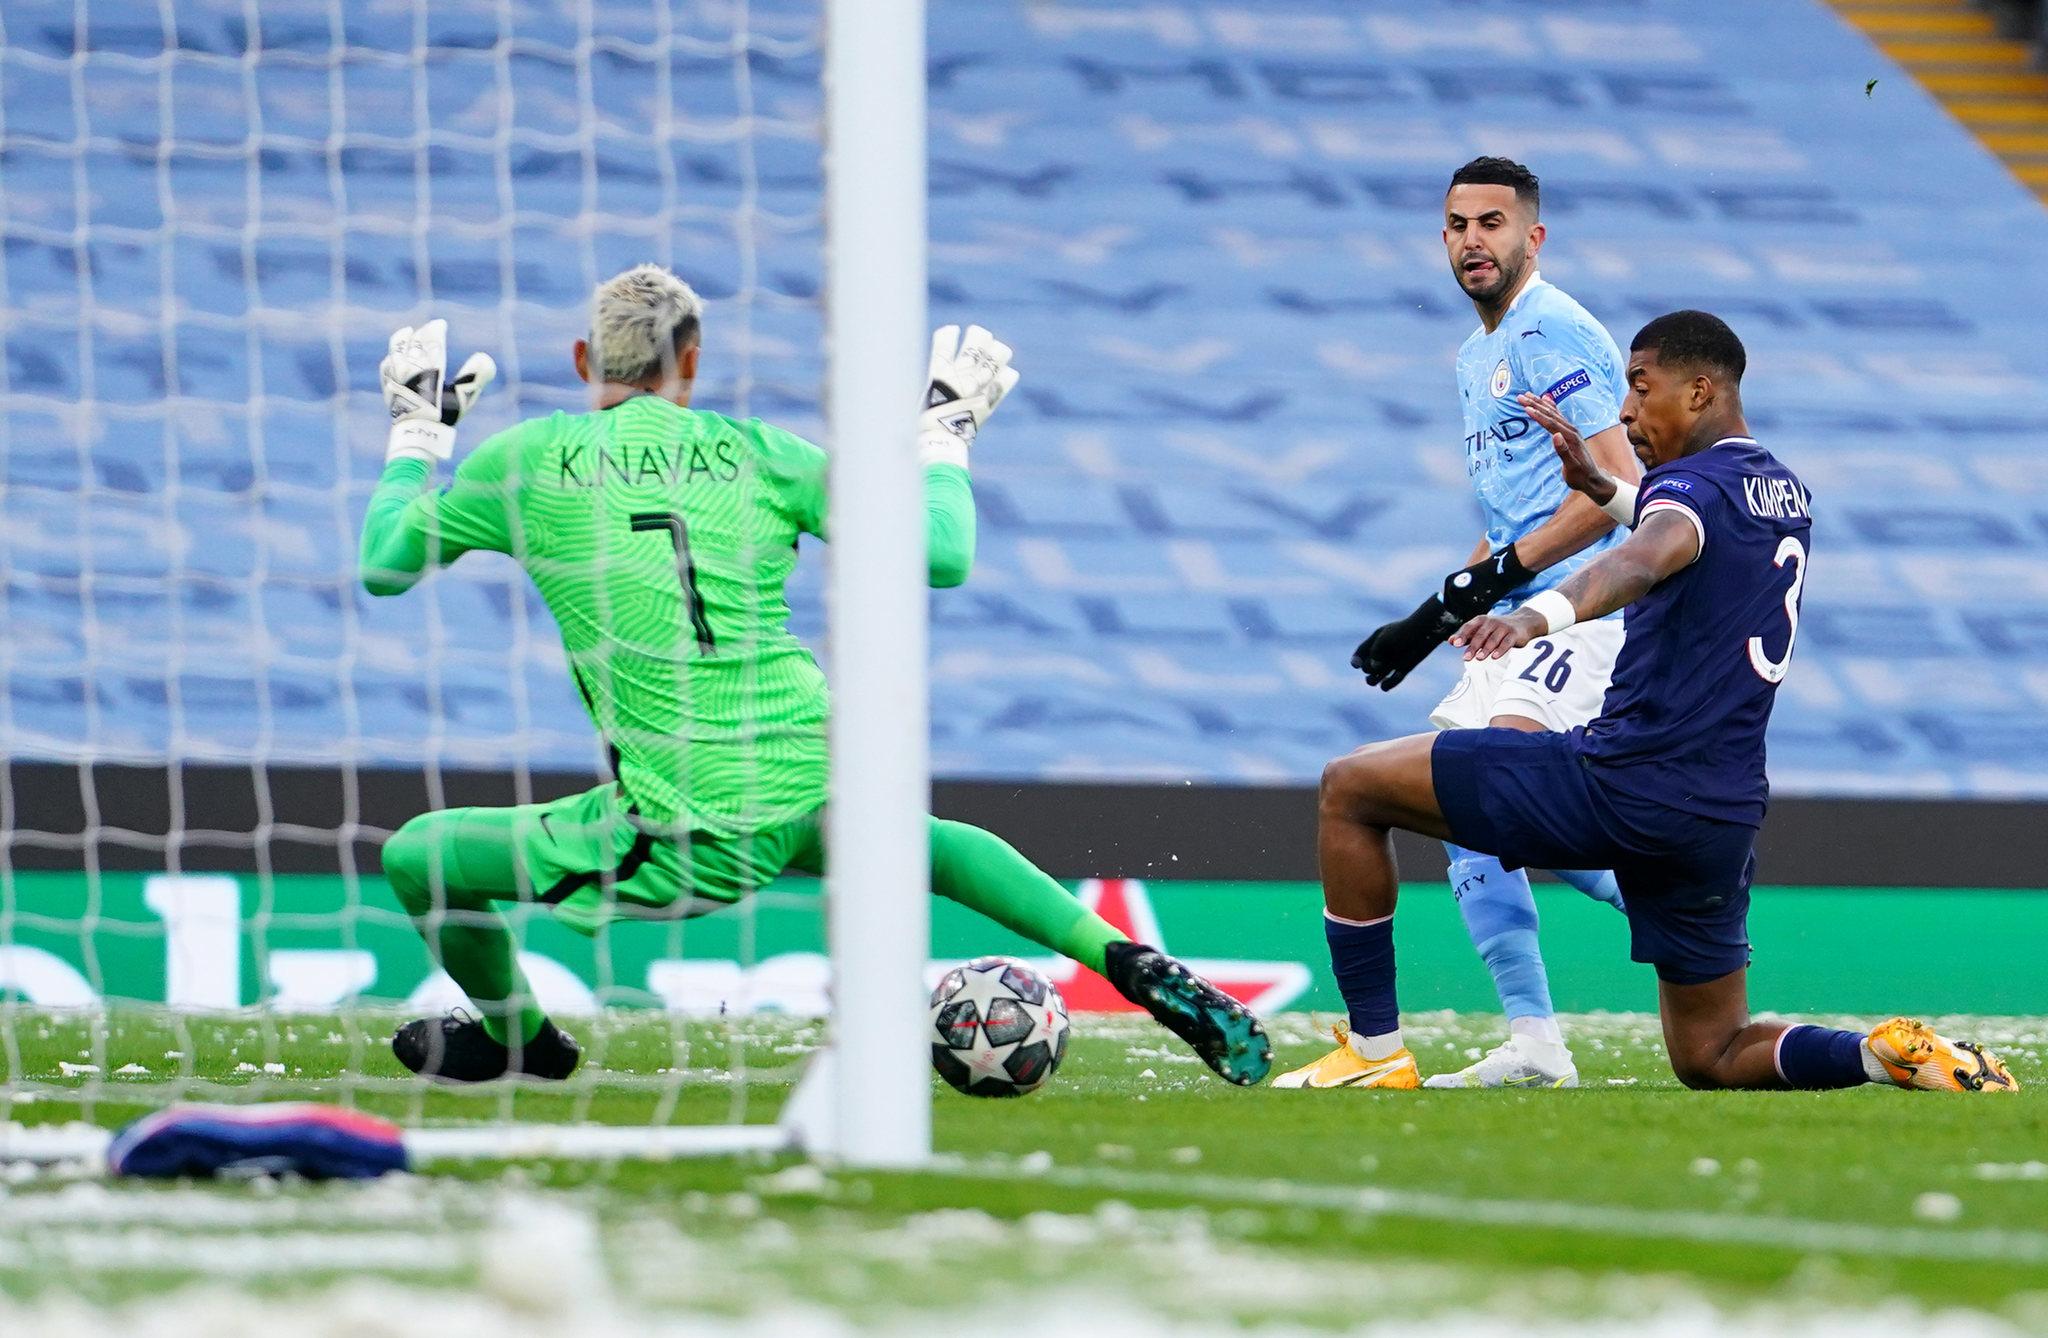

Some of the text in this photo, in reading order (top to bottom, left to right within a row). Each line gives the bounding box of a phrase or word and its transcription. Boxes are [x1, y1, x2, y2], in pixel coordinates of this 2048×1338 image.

[1552, 373, 1588, 399] RESPECT
[561, 440, 739, 488] K.NAVAS
[630, 512, 717, 658] 7
[1747, 536, 1806, 683] 3
[1518, 640, 1574, 693] 26
[1454, 873, 1486, 902] CITY
